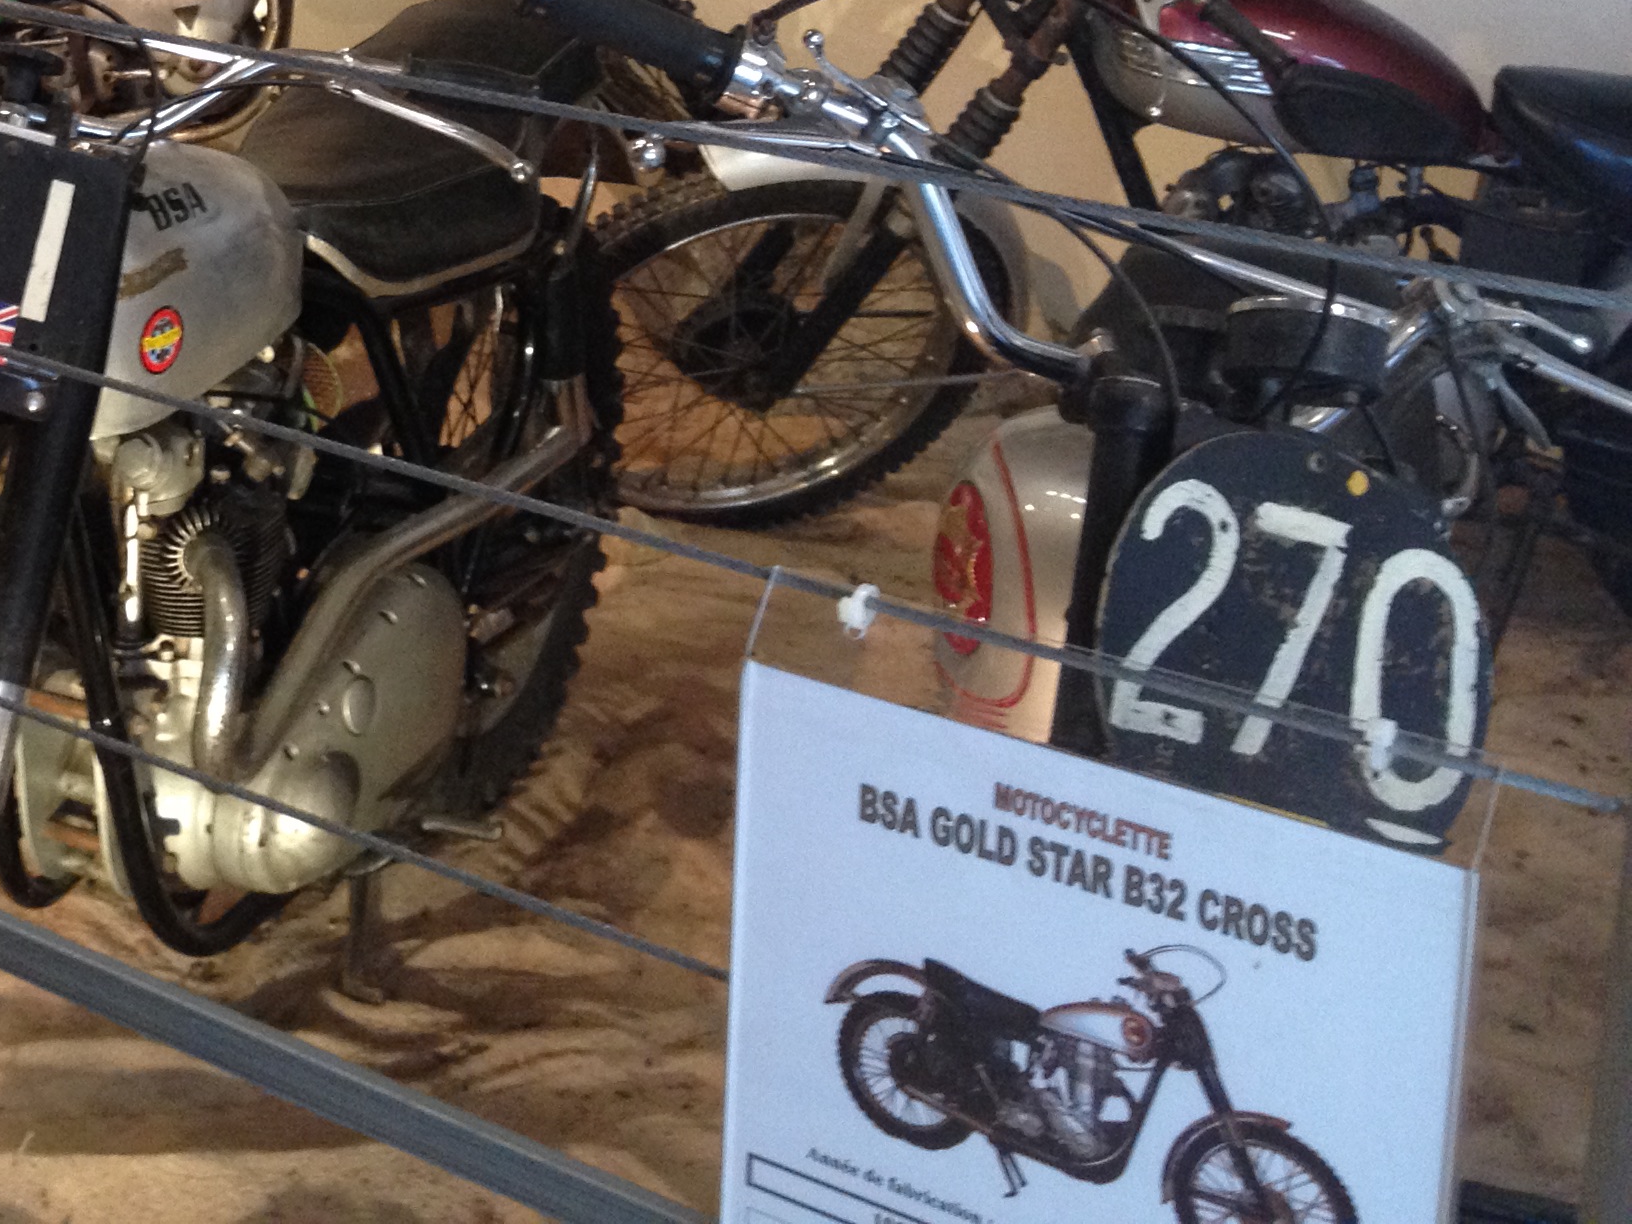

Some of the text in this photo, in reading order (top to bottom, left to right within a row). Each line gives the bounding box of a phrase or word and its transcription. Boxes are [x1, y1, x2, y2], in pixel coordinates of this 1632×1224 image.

[145, 181, 207, 231] BSA
[1108, 479, 1481, 812] 270
[859, 783, 1318, 962] BSA GOLD STAR B32 CROSS
[993, 781, 1173, 860] MOTOCYCLETTE
